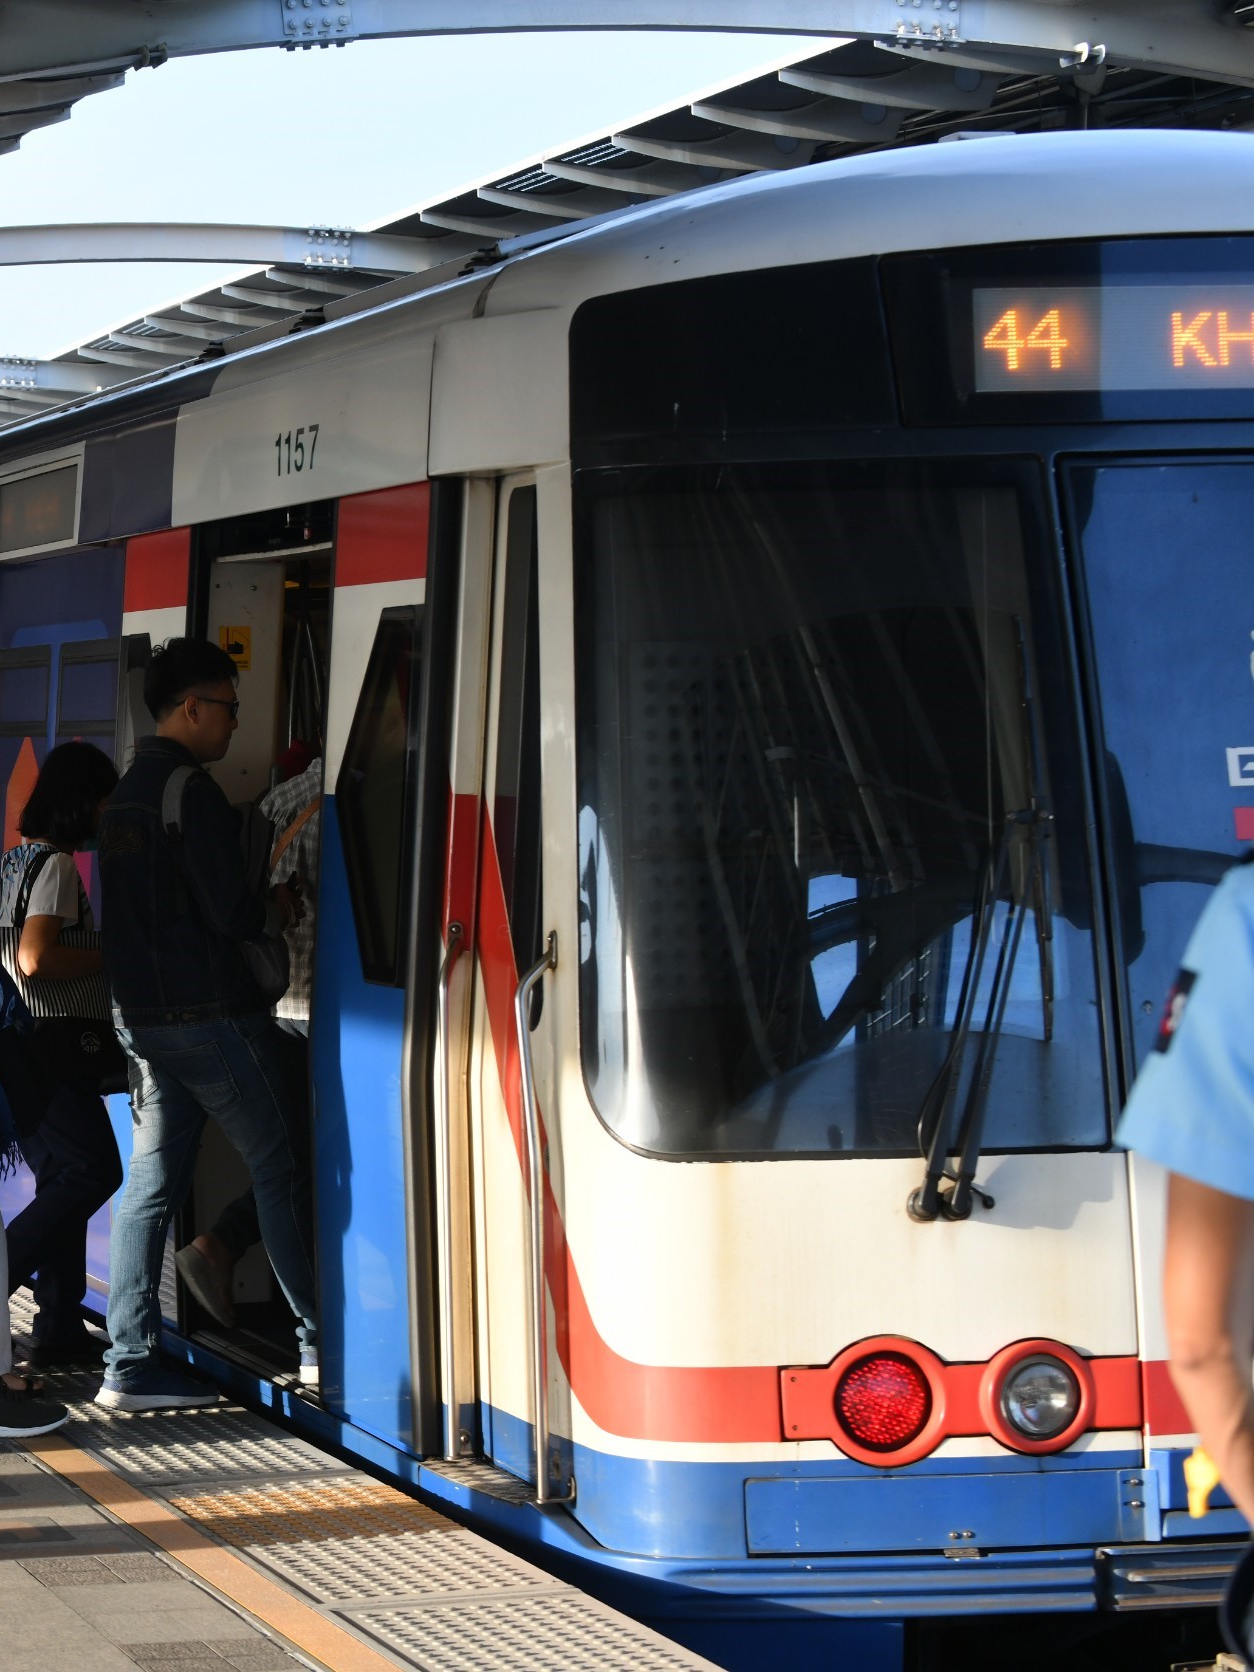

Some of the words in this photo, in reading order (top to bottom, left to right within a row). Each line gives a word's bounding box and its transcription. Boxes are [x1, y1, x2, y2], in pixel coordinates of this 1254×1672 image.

[982, 309, 1069, 370] 44
[1171, 310, 1254, 368] KH
[275, 423, 320, 476] 1157
